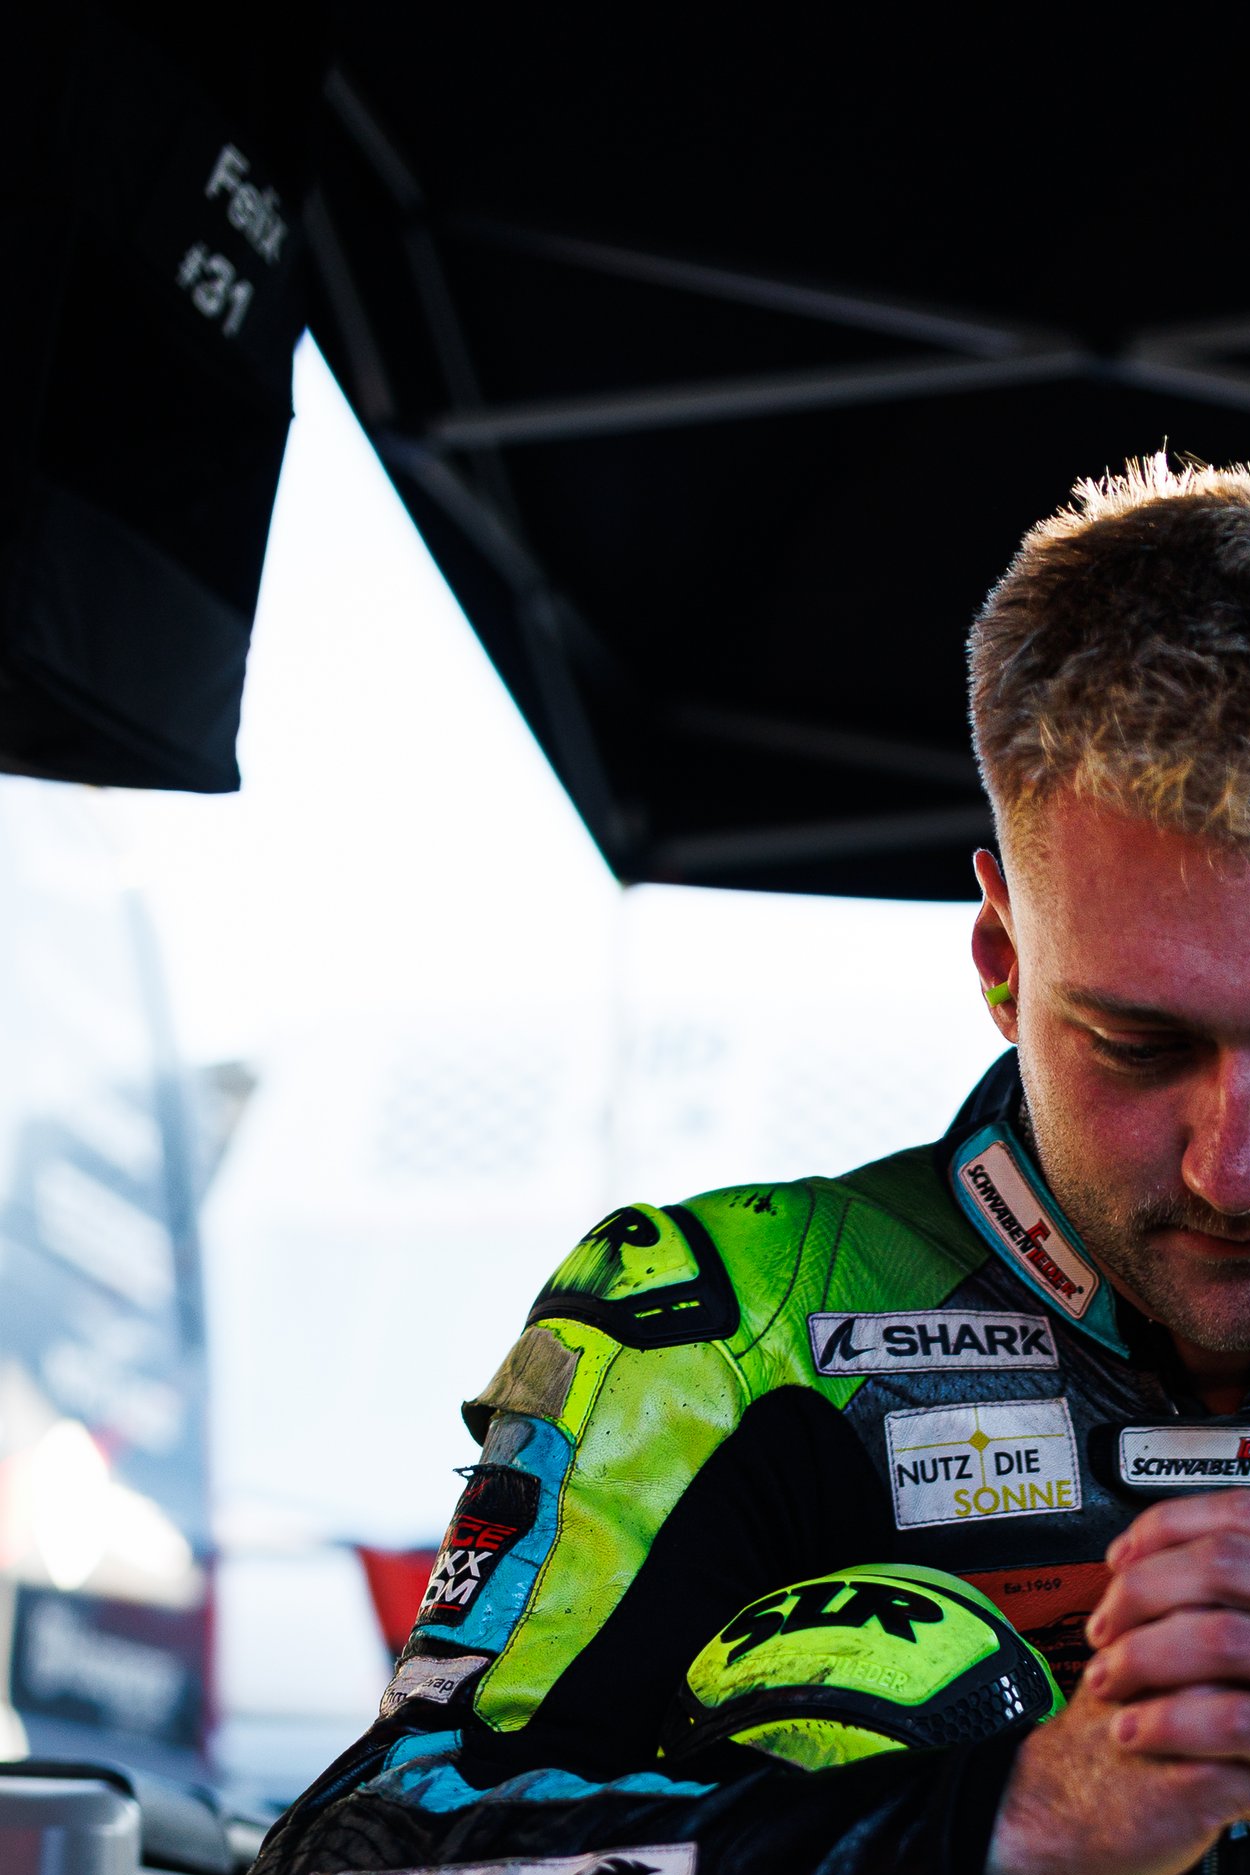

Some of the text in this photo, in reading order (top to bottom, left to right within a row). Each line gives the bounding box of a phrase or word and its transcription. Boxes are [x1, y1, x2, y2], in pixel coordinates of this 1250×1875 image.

[882, 1323, 1053, 1357] SHARK
[896, 1449, 1041, 1487] NUTZ DIE
[953, 1480, 1073, 1518] SONNE
[720, 1581, 944, 1668] SLR
